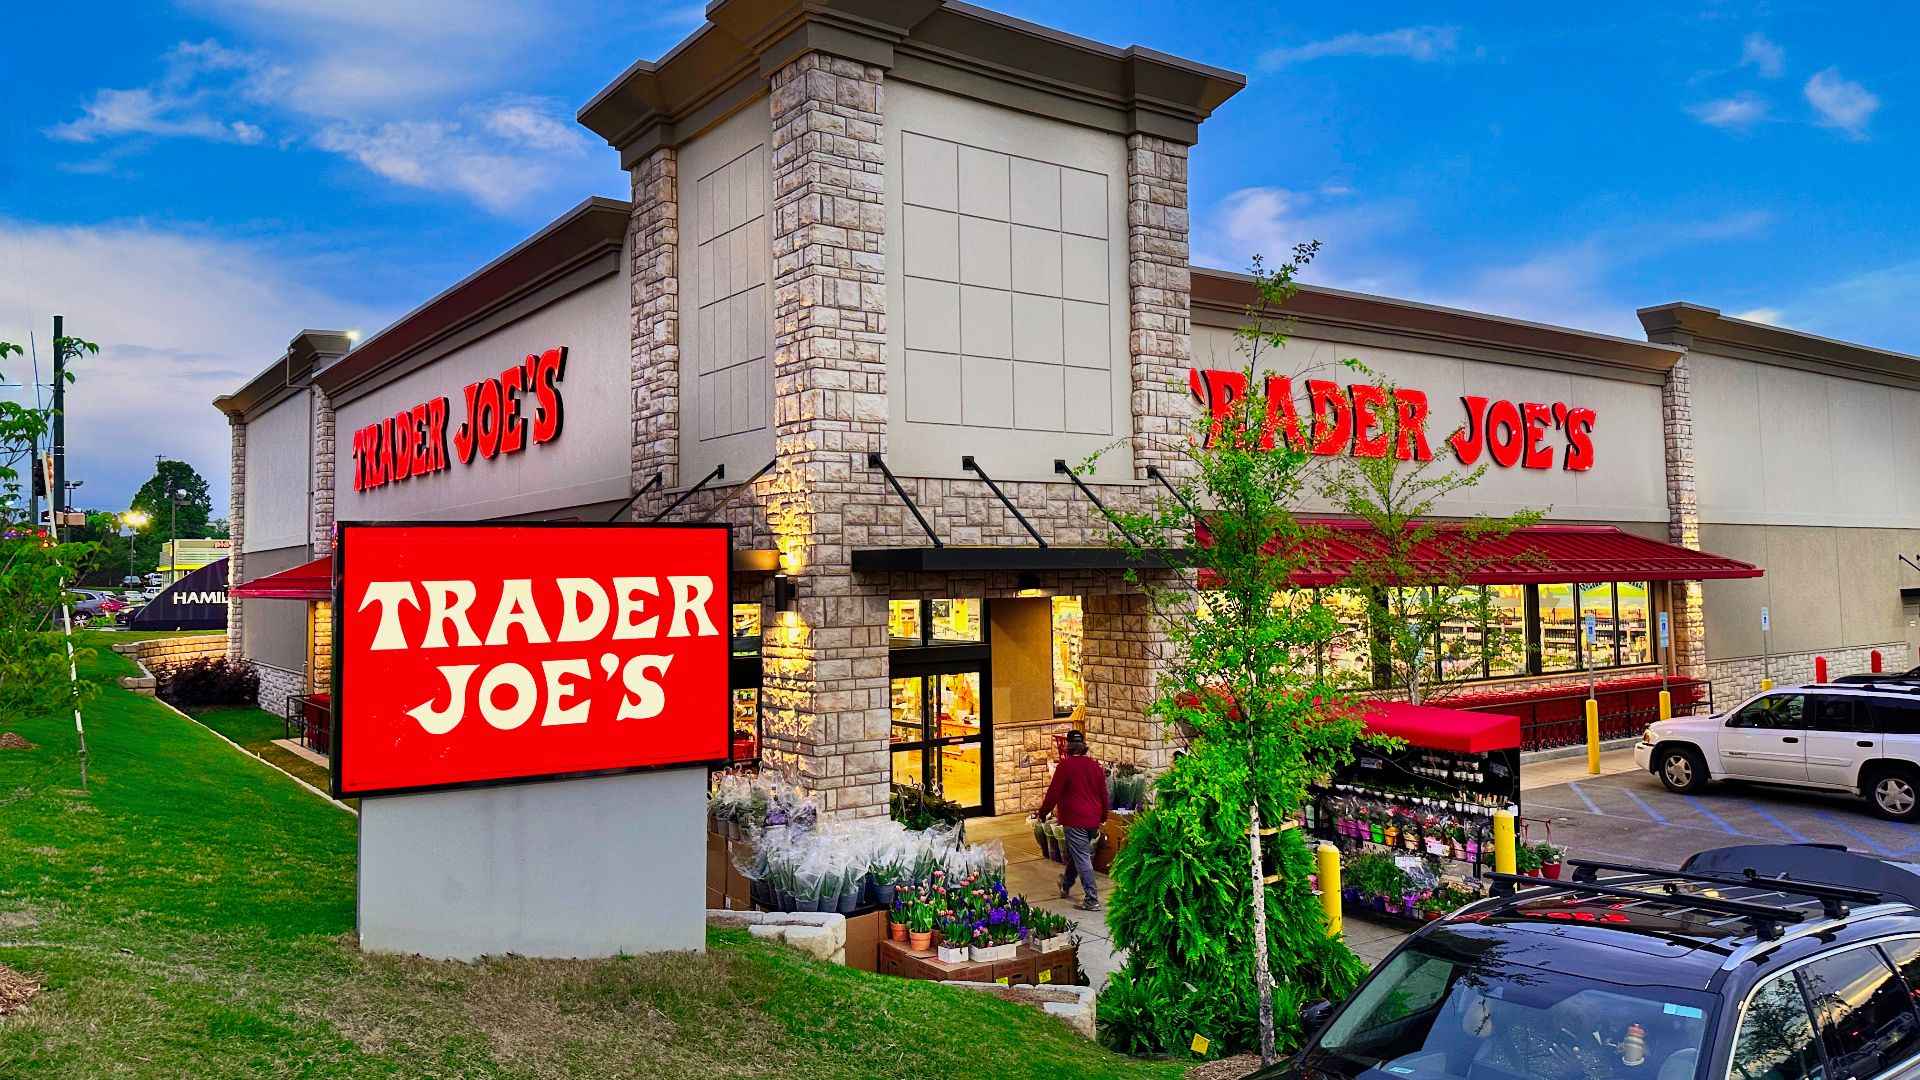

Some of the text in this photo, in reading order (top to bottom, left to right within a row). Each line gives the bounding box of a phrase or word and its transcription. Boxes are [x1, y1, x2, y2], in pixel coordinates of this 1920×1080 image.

[353, 346, 568, 491] TRADER JOE'S
[1190, 368, 1596, 471] RADER JOE'S
[358, 575, 719, 651] TRADER
[406, 653, 675, 735] JOE'S
